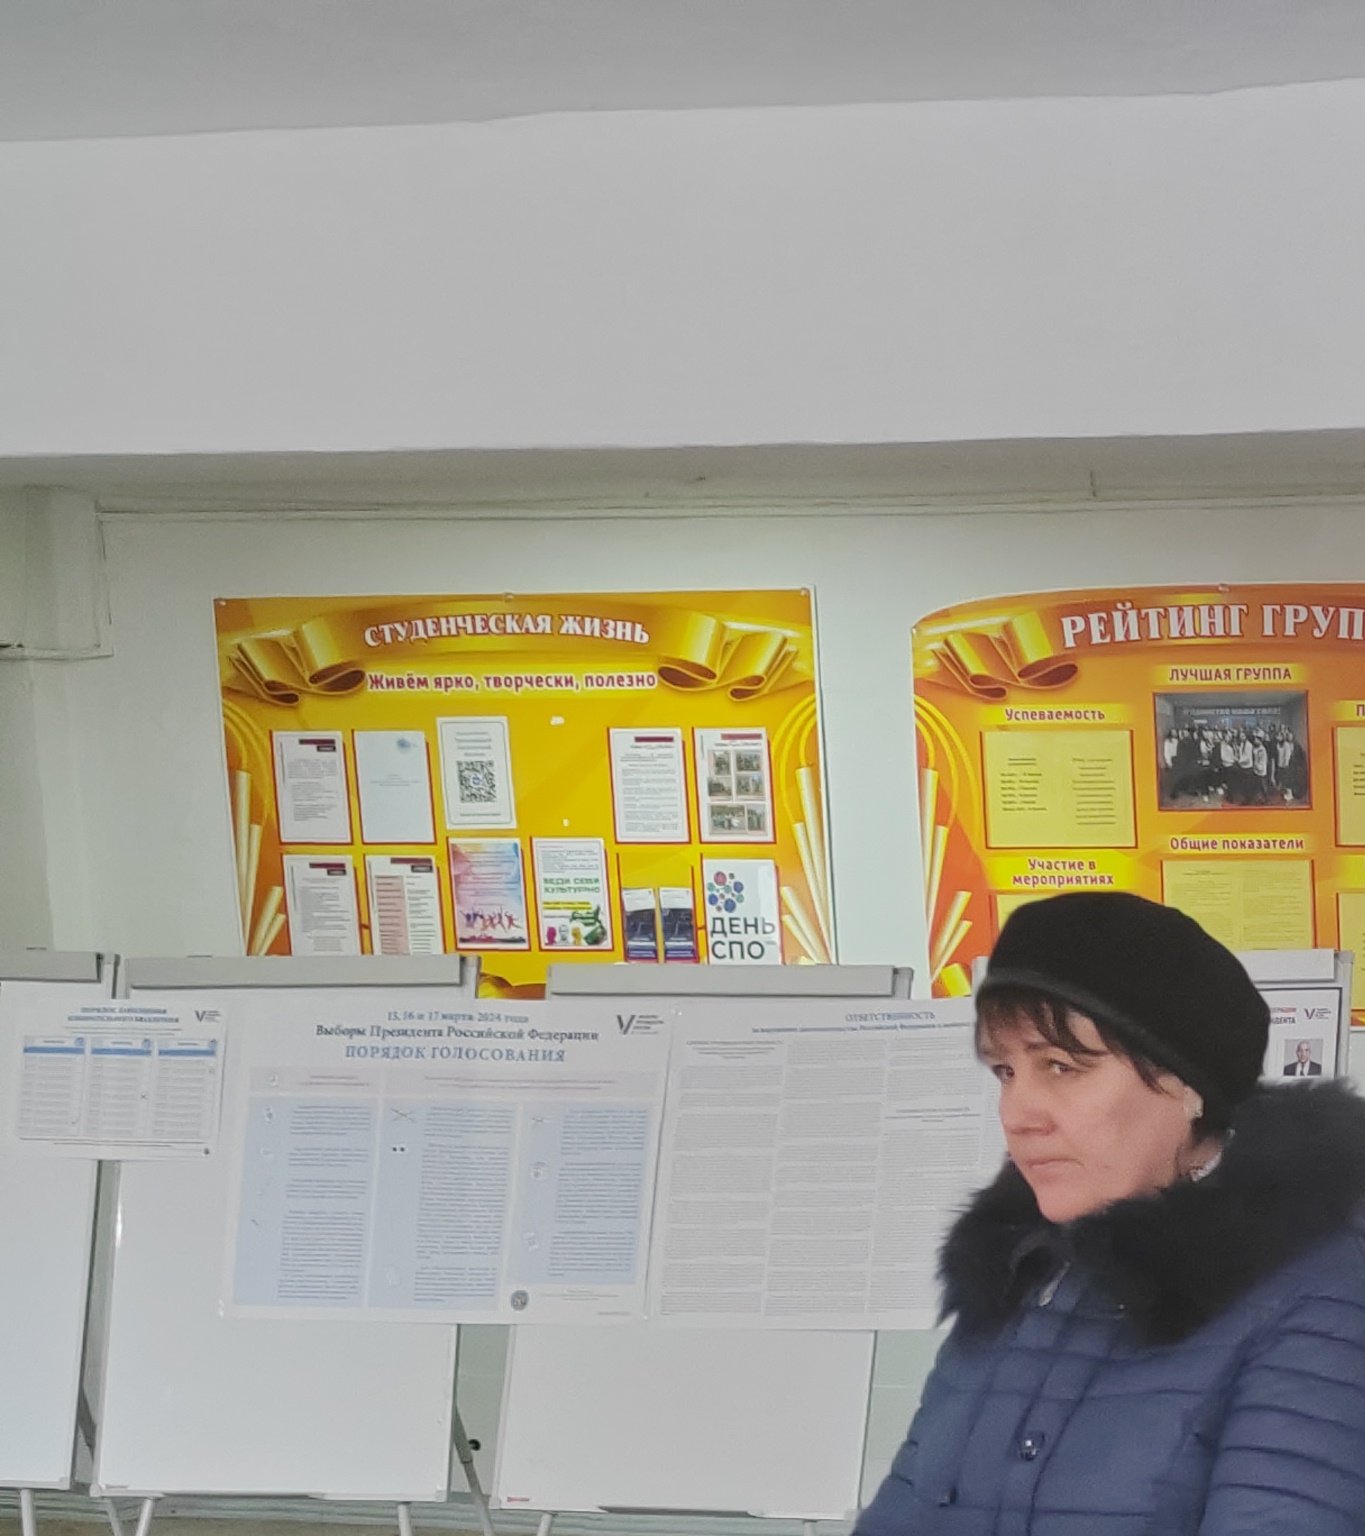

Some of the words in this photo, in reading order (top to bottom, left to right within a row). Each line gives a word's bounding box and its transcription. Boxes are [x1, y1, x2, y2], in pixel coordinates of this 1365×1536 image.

[364, 613, 552, 647] СТУДЕНЧЕСКАЯ
[559, 614, 650, 645] ЖИЗНЬ
[1060, 601, 1248, 648] РЕЙТИНГ
[1169, 667, 1232, 682] ЛУЧШАЯ
[1236, 666, 1292, 681] ГРУППА
[369, 673, 428, 690] Живём
[434, 675, 479, 693] ярко,
[484, 674, 580, 693] творчески,
[584, 674, 656, 689] полезно
[1005, 708, 1106, 721] Успеваемость
[1170, 837, 1218, 851] Общие
[1222, 838, 1304, 850] показатели
[1028, 858, 1085, 874] Участие
[1089, 860, 1096, 870] в
[1012, 874, 1114, 888] мероприятиях
[710, 917, 776, 938] ДЕНЬ
[711, 940, 766, 960] СПО
[344, 1045, 426, 1060] ПОРЯДОК
[431, 1046, 566, 1062] ГОЛОСОВАНИЯ
